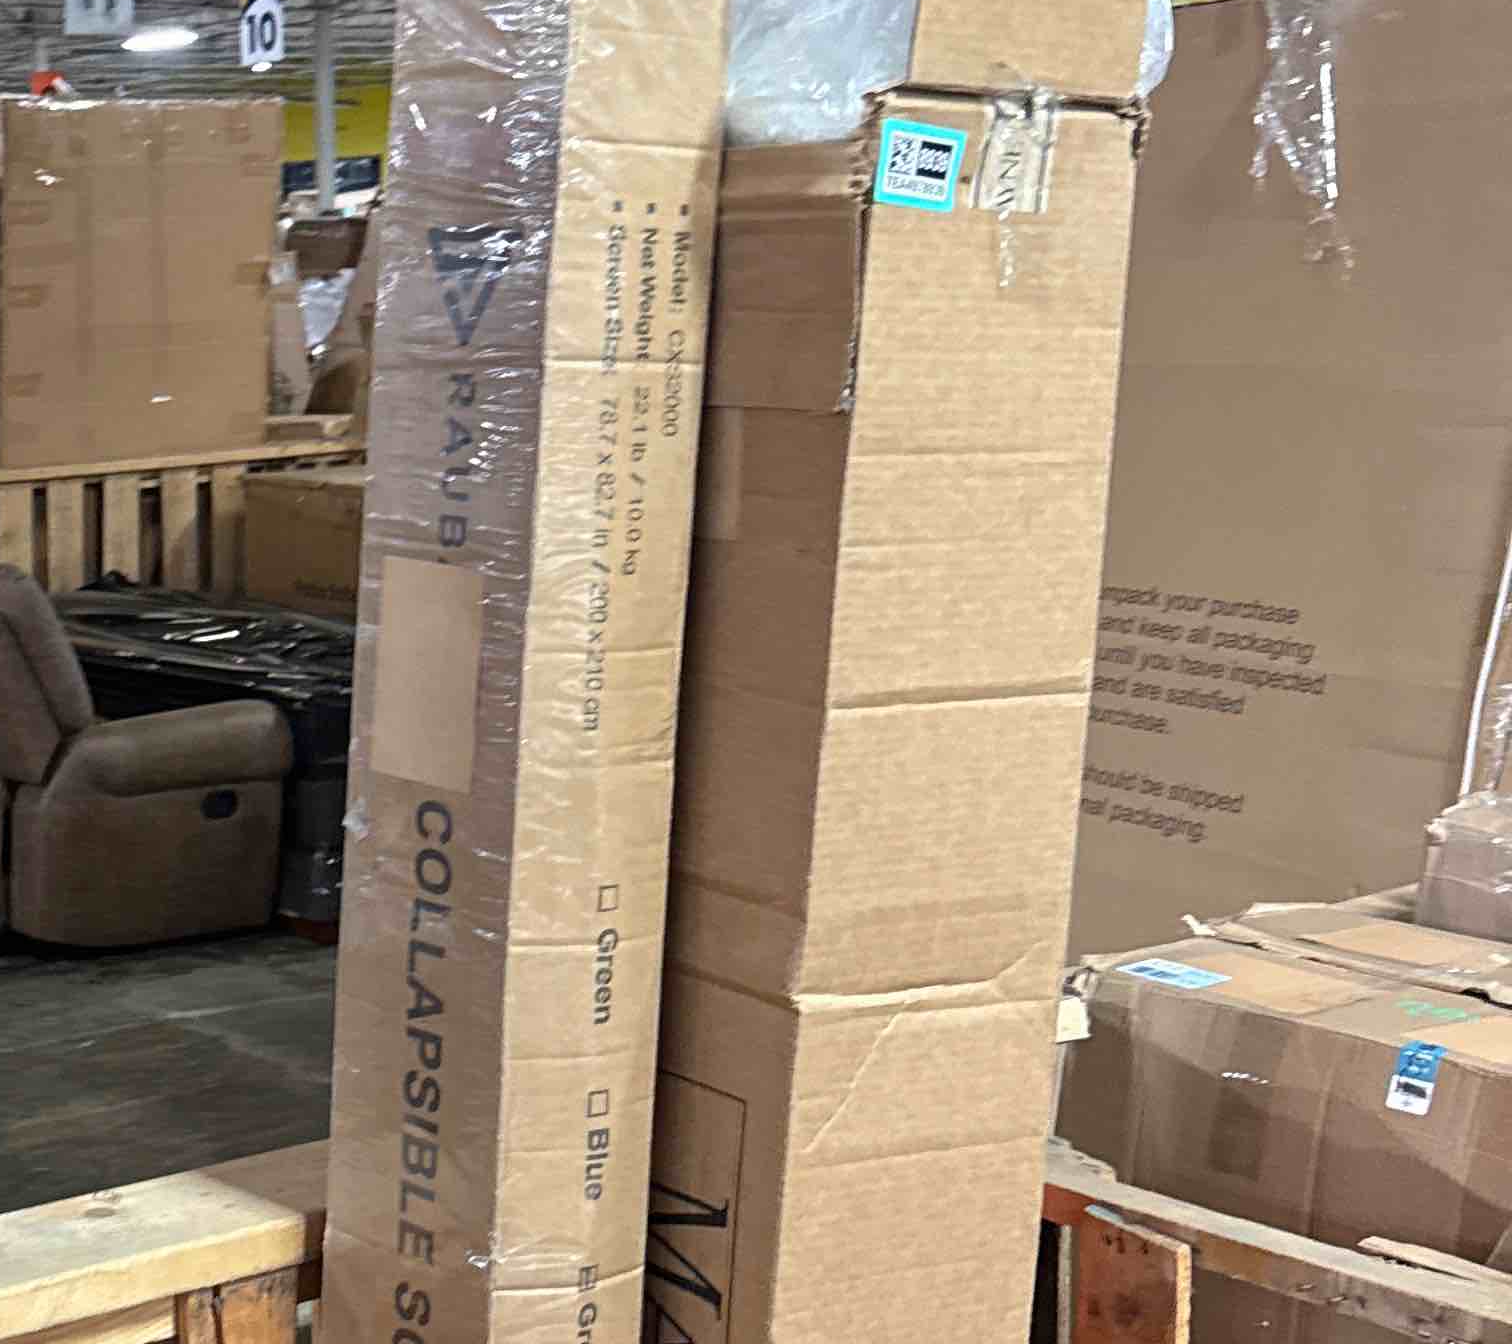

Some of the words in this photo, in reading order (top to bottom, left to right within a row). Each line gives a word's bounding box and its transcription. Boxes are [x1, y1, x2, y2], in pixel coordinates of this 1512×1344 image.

[248, 12, 277, 54] 10
[642, 226, 660, 263] Net
[583, 698, 601, 732] cm
[593, 927, 620, 1026] Green
[396, 798, 453, 1266] COLLAPSIBLE
[583, 1127, 610, 1202] Blue
